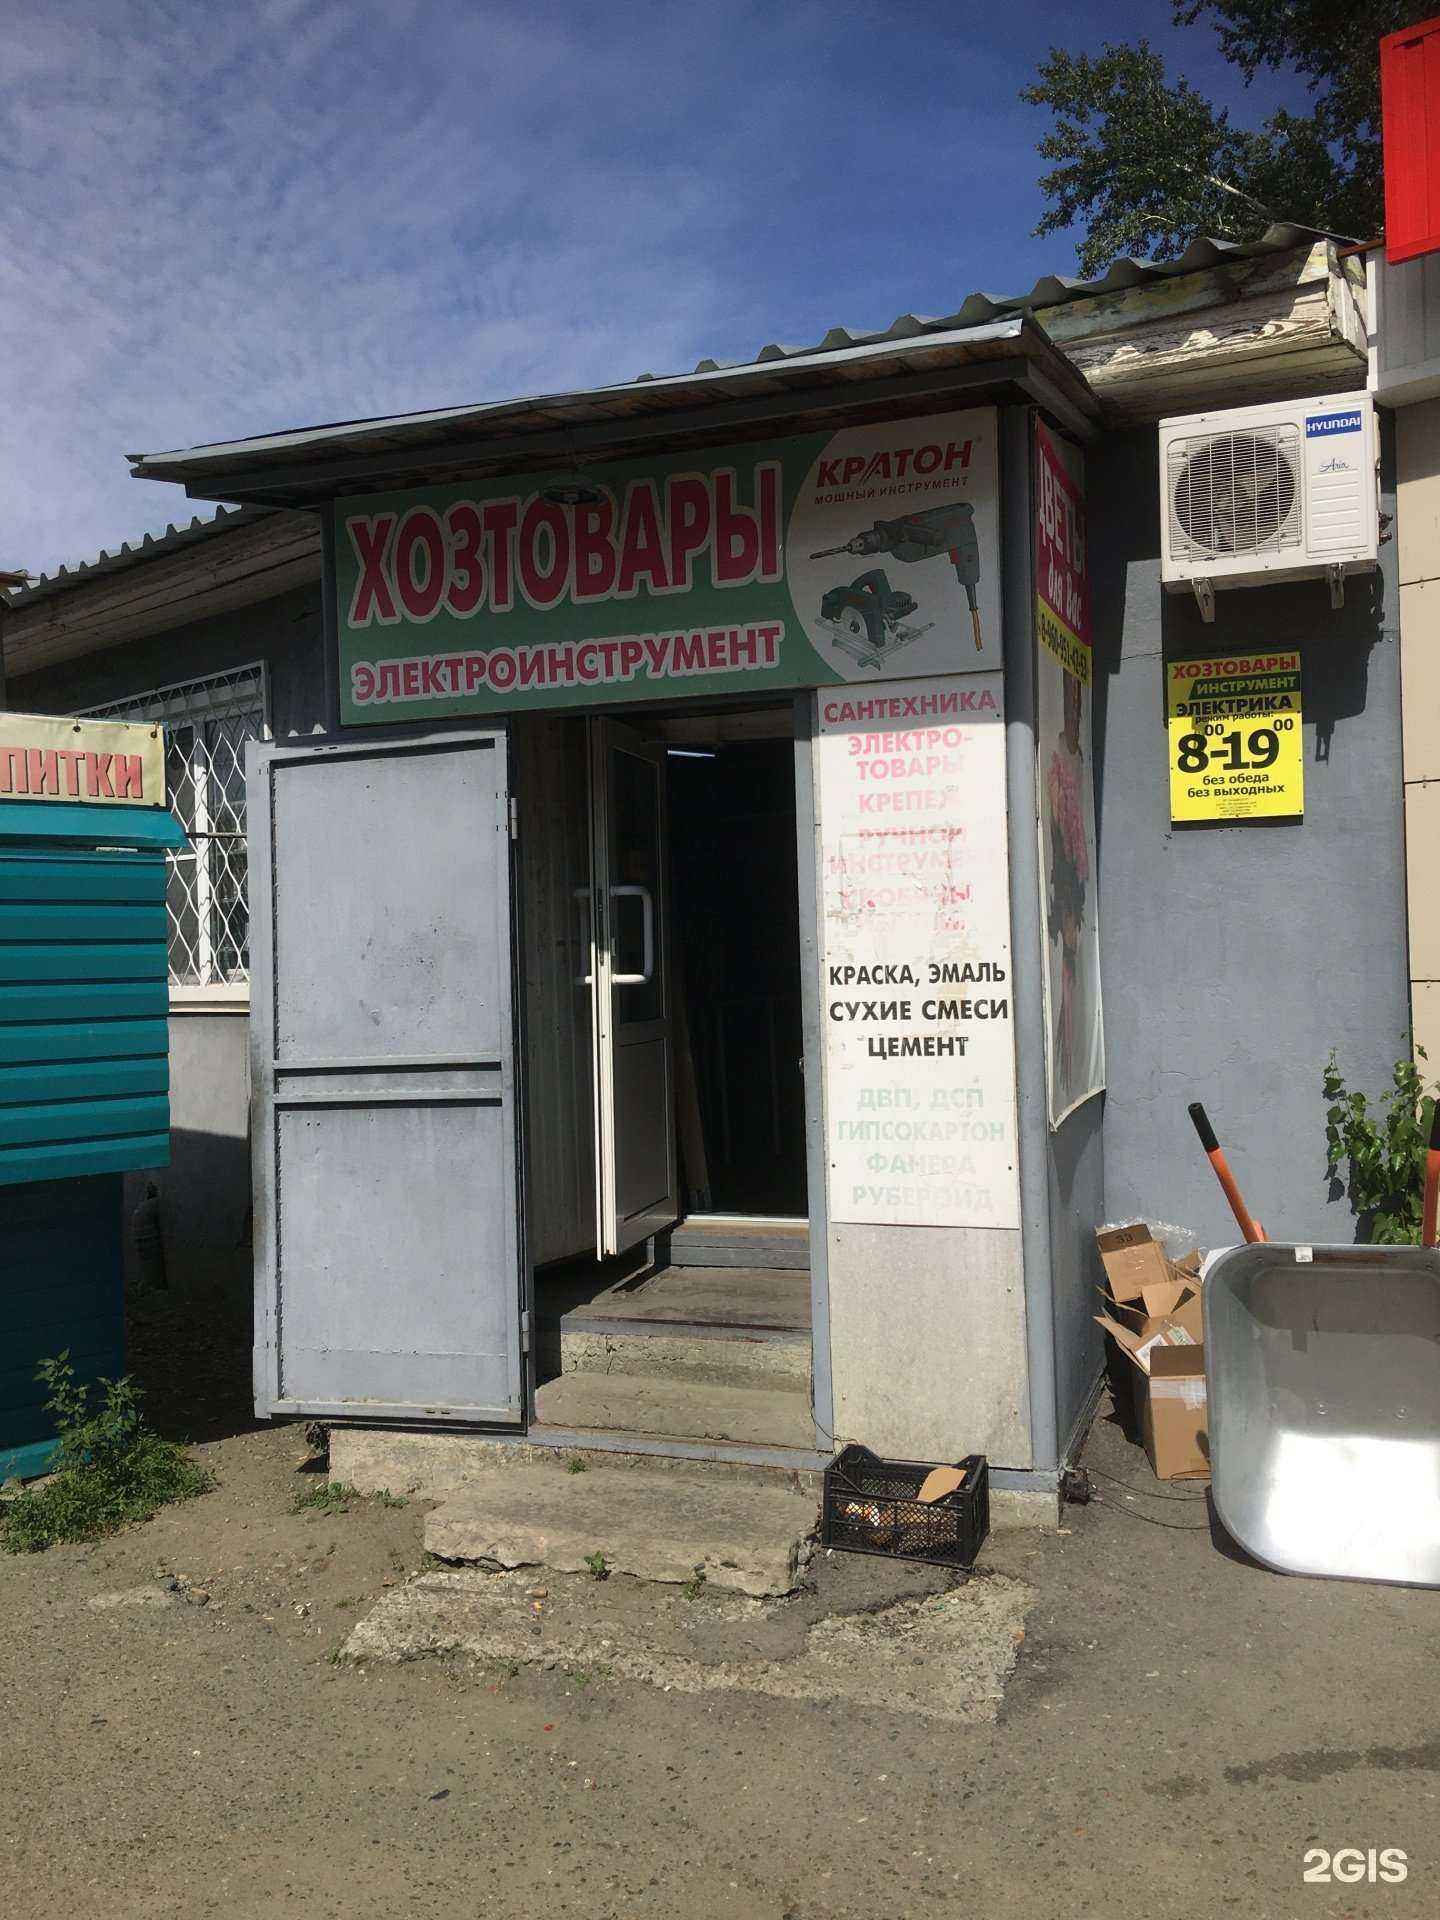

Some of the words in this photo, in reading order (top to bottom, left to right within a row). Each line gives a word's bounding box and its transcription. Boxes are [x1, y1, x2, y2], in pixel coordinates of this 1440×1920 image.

[1306, 416, 1361, 432] HYUNDAI
[816, 439, 974, 488] КРАТОН
[814, 487, 876, 505] МОЩНЫЙ
[879, 476, 968, 497] ИНСТРУМЕНТ
[346, 461, 783, 627] ХОЗТОВАРЫ
[350, 622, 784, 704] ЭЛЕКТРОИНСТРУМЕНТ
[1172, 654, 1298, 681] ХОЗТОВАРЫ
[1197, 676, 1297, 696] ИНСТРУМЕНТ
[823, 690, 996, 724] САНТЕХНИКА
[1176, 694, 1293, 717] ЭЛЕКТРИКА
[848, 728, 974, 756] ЭЛЕКТРО-
[1187, 788, 1210, 798] без
[1214, 785, 1285, 797] выходных
[1203, 775, 1225, 786] без
[1229, 773, 1270, 785] обеда
[829, 964, 920, 987] КРАСКА,
[928, 963, 1007, 984] ЭМАЛЬ
[829, 1001, 912, 1022] СУХИЕ
[921, 999, 1009, 1020] СМЕСИ
[868, 1037, 969, 1060] ЦЕМЕНТ
[929, 1087, 984, 1111] ДСП
[838, 1120, 1006, 1142] ГИПСОКАРТОН
